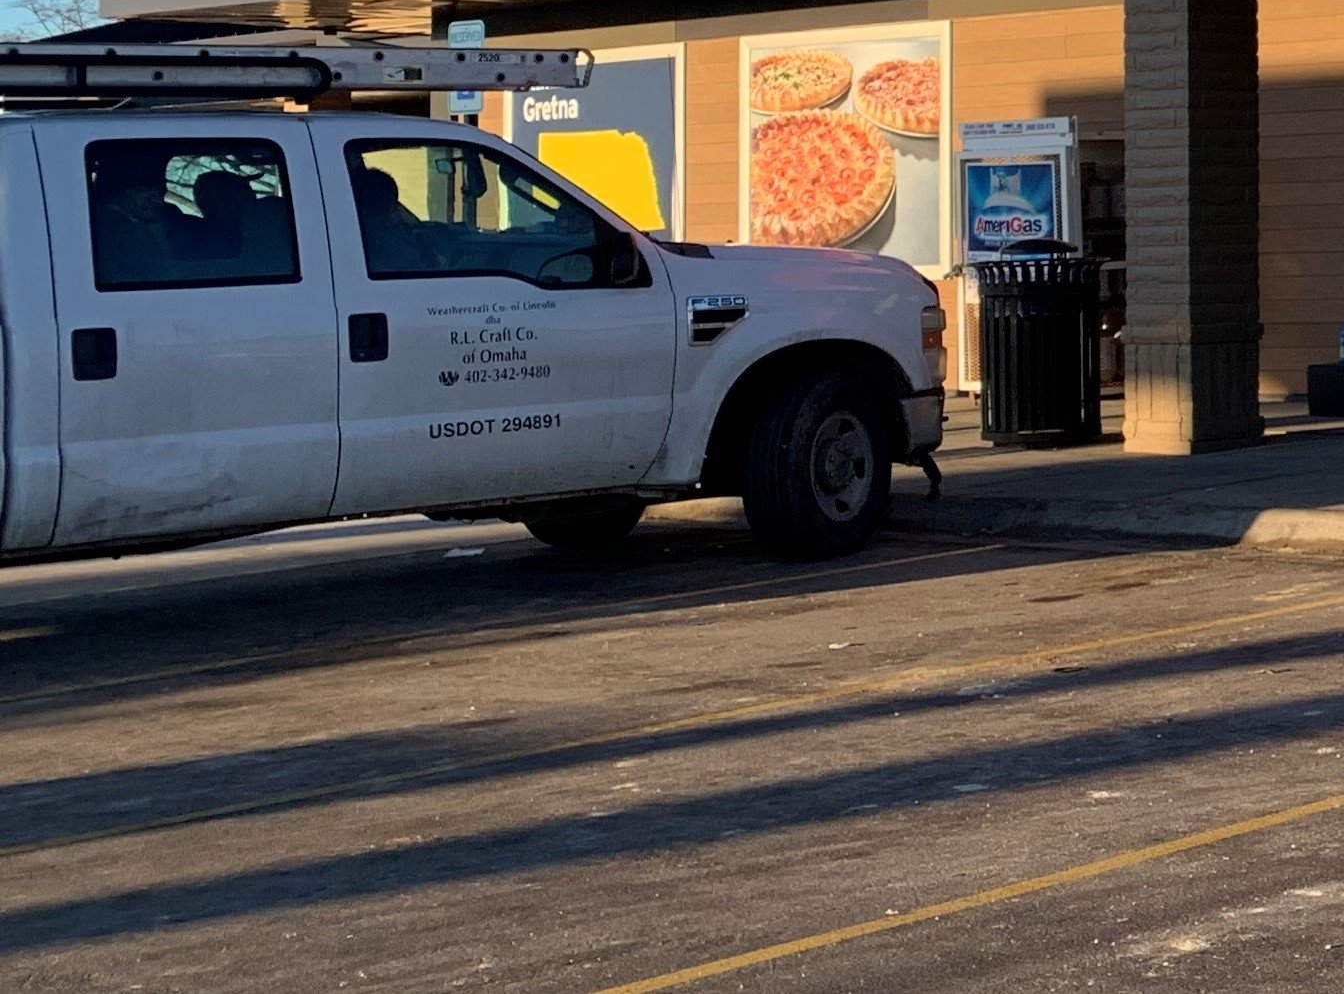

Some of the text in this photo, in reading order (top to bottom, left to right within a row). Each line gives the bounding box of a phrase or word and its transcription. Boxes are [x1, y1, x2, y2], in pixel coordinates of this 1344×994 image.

[523, 95, 578, 123] Gretna
[976, 216, 1042, 233] AmeriGas
[427, 300, 556, 316] Weathercraft Co. of Lincoln
[485, 315, 501, 324] dba
[450, 327, 538, 345] R.L. Craft Co.
[463, 347, 527, 364] of Omaha
[464, 364, 551, 383] 402-342-9480
[429, 413, 561, 439] USDOT 294891
